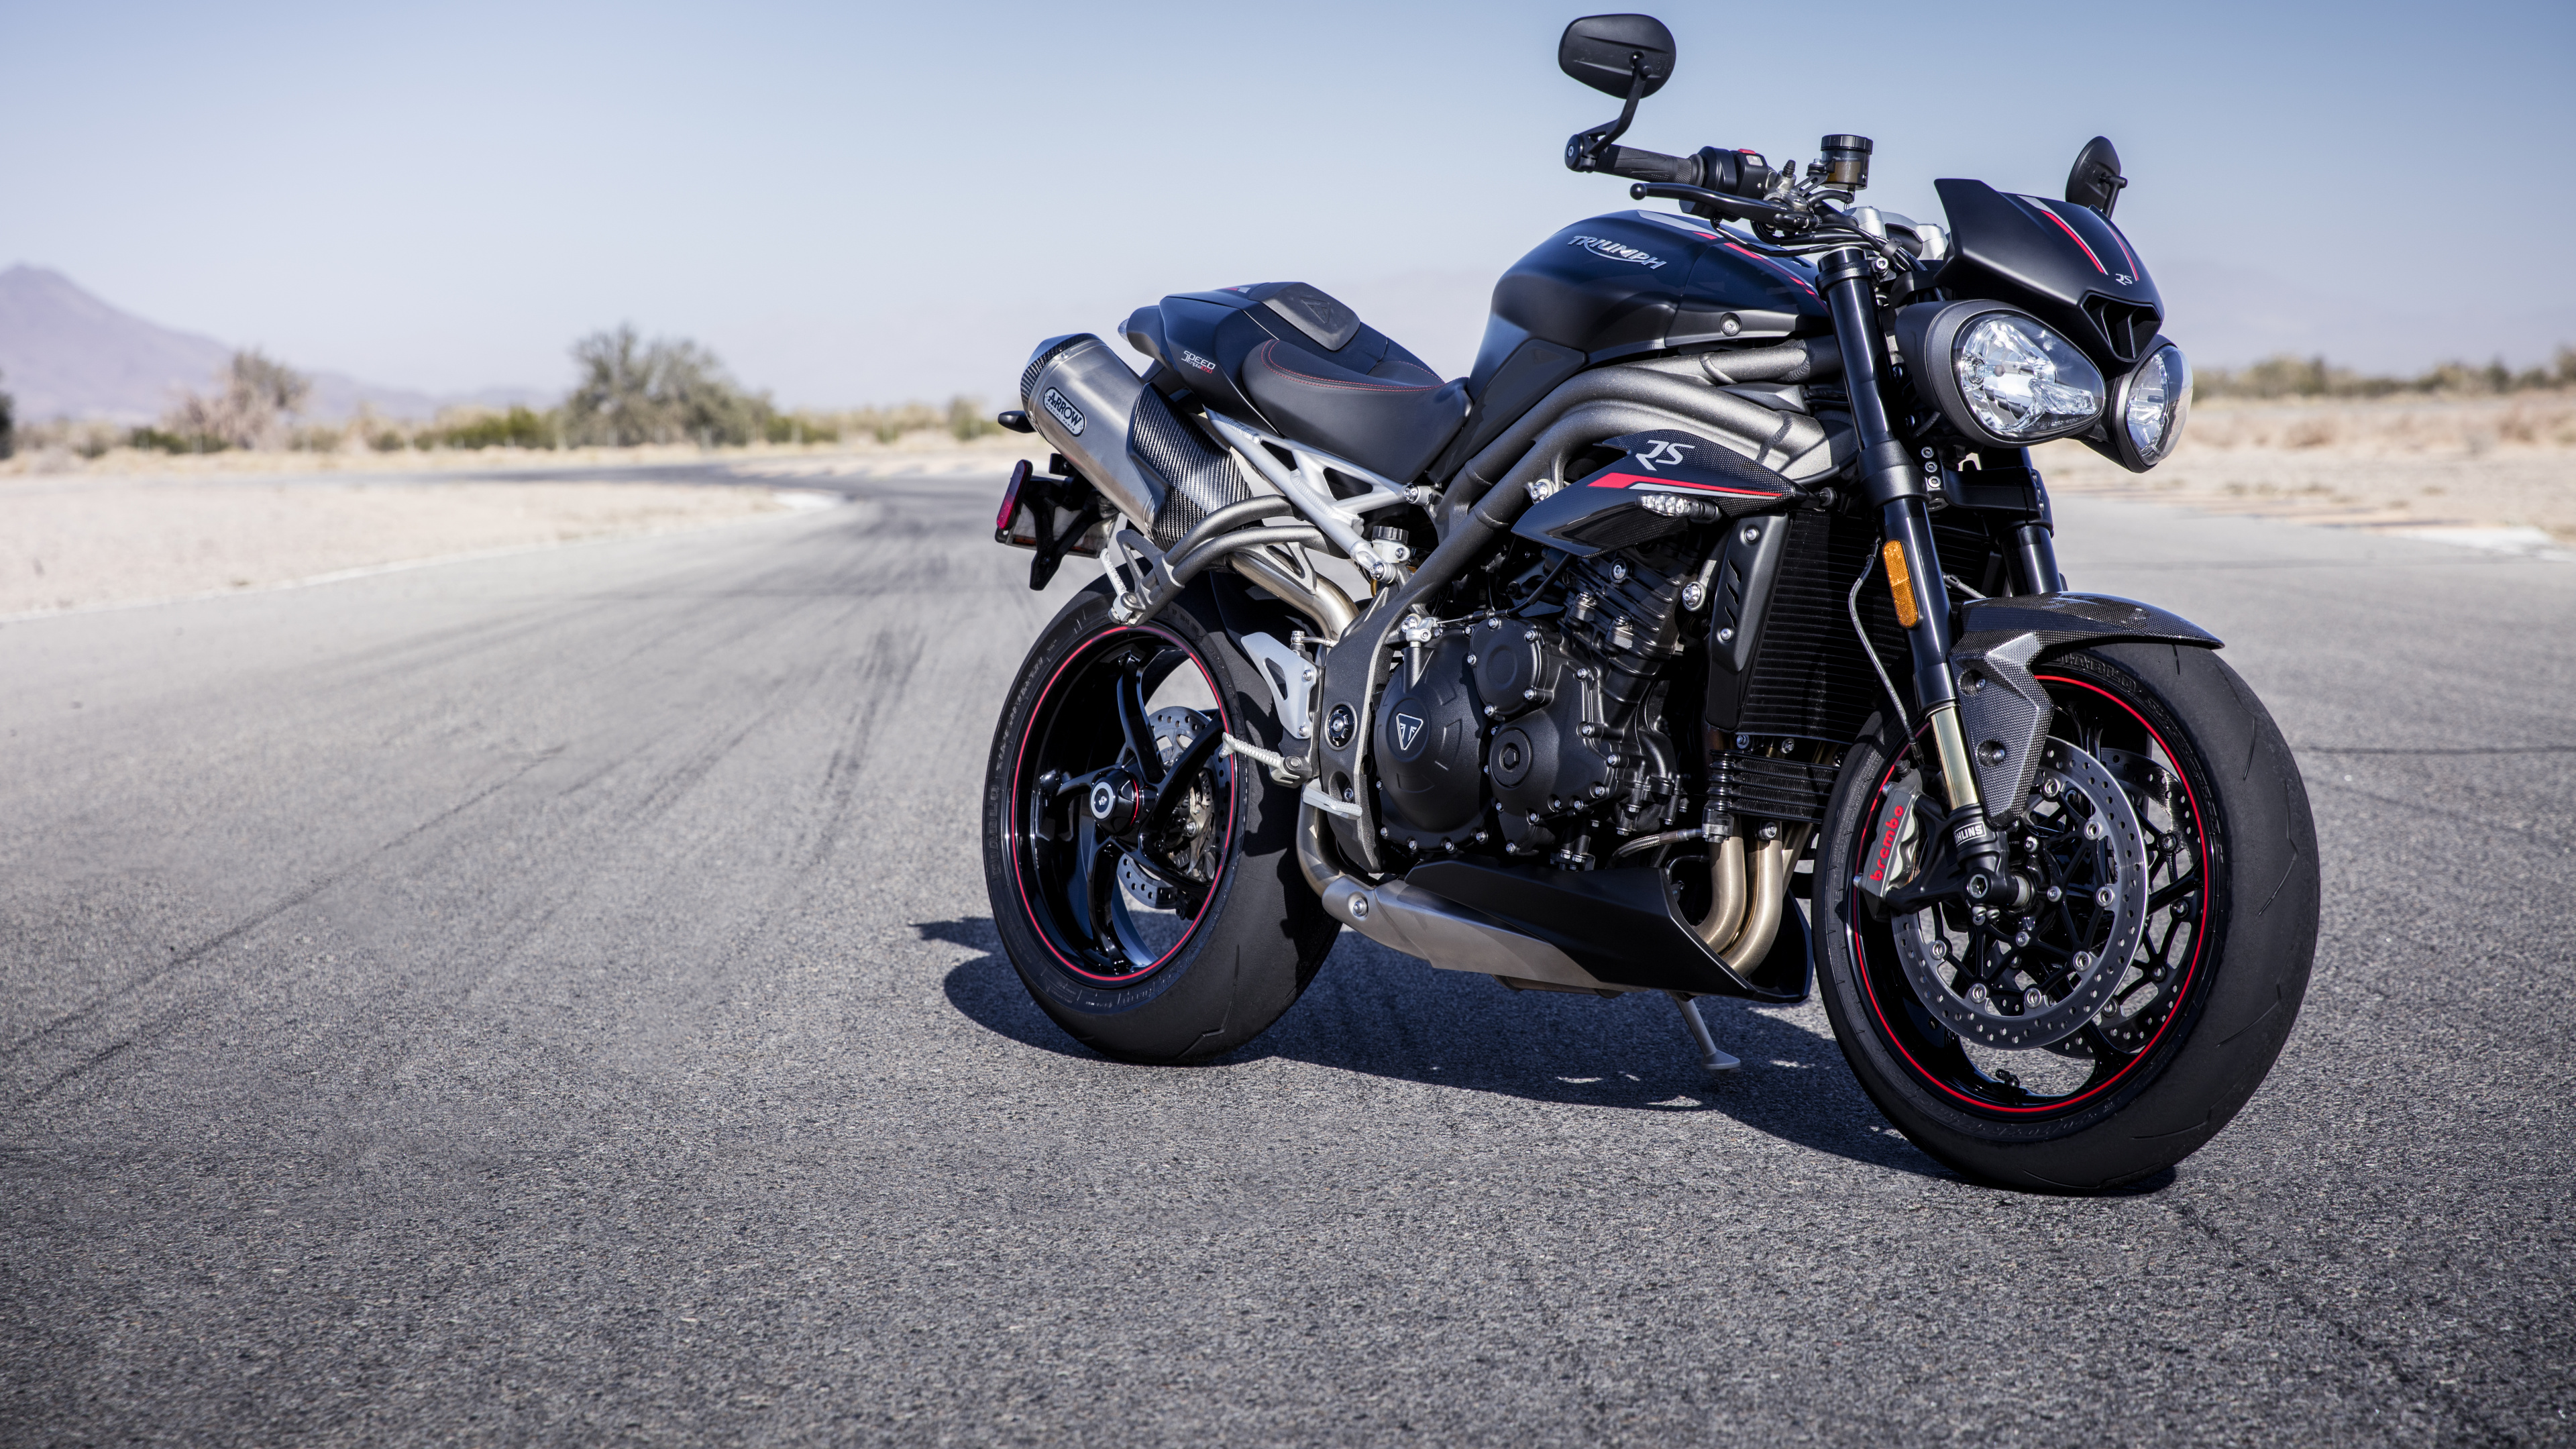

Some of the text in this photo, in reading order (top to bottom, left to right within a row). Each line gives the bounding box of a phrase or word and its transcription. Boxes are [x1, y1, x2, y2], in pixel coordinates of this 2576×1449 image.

[1568, 235, 1667, 270] TRIUMPH
[2115, 273, 2133, 286] RS
[1181, 350, 1216, 370] SPEED
[1046, 402, 1075, 431] SPECIAL PARTS
[1048, 392, 1082, 426] ARROW
[1635, 439, 1696, 471] RS
[989, 785, 1001, 875] DIABLO
[1870, 805, 1904, 881] brembo
